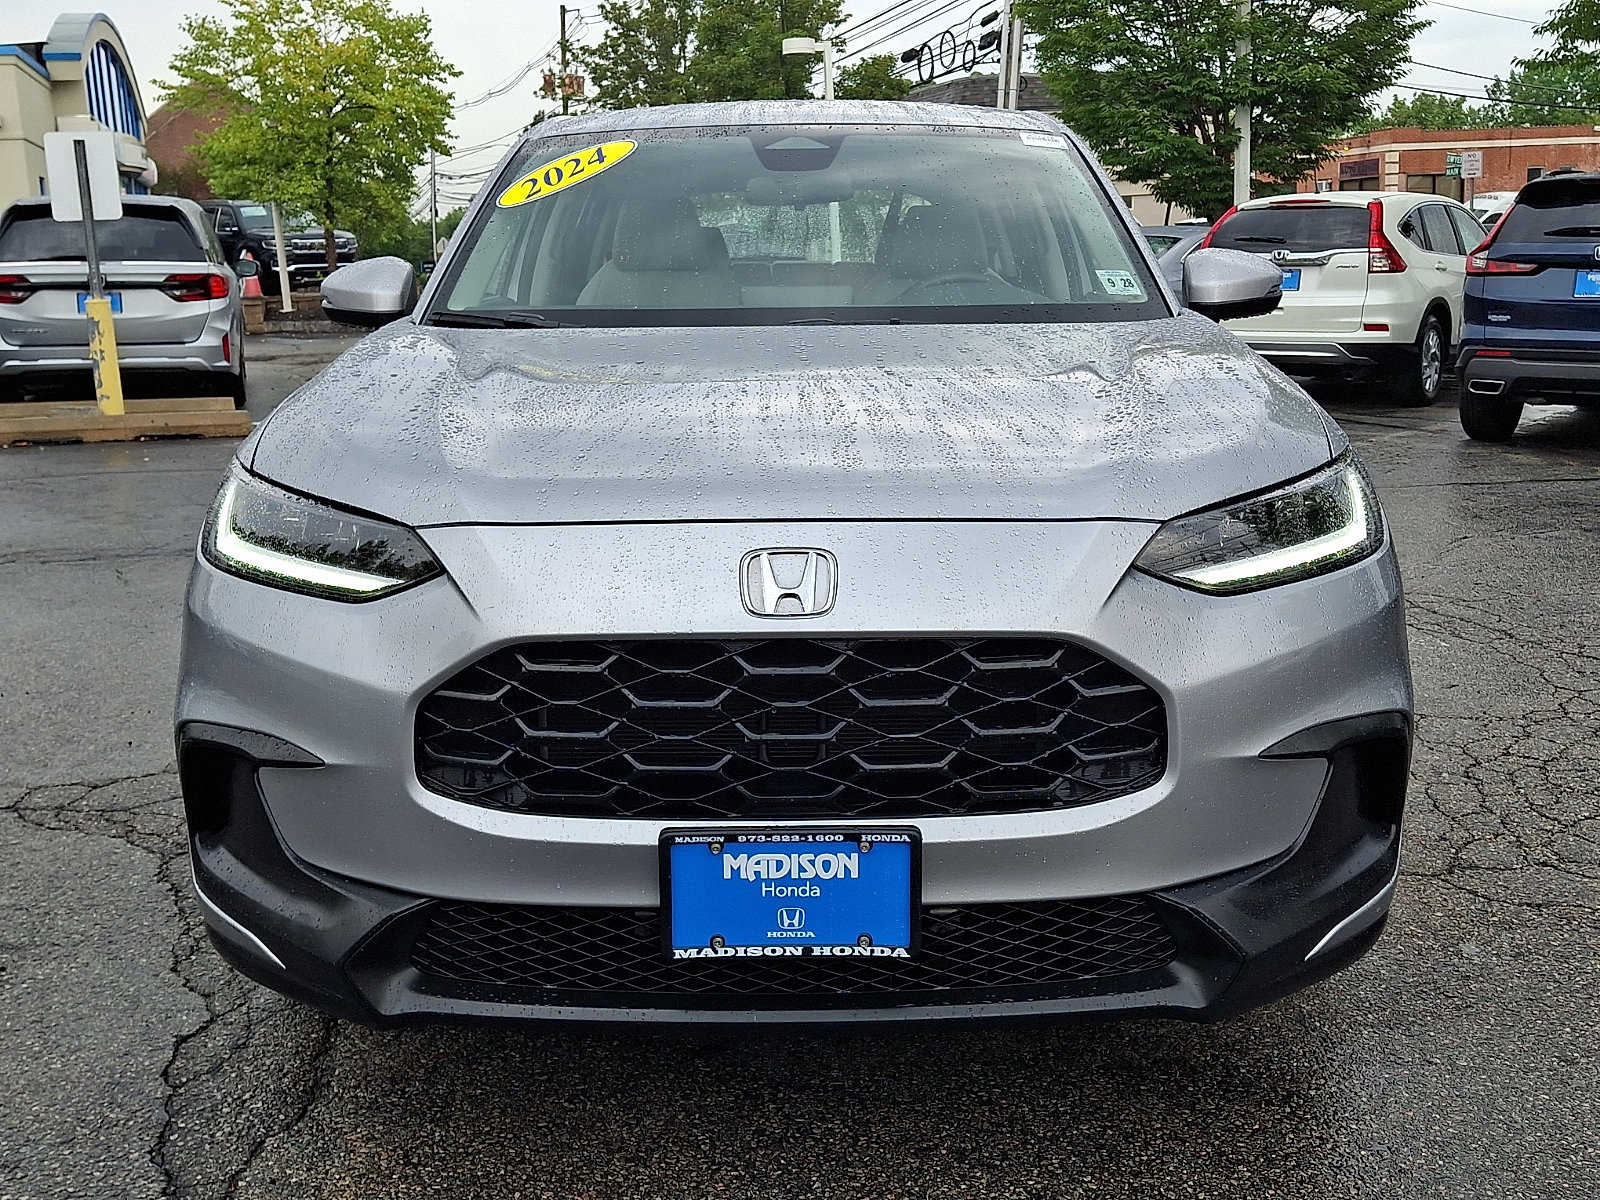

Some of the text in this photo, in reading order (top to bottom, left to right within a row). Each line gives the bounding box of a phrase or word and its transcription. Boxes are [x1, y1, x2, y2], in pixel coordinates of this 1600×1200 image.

[521, 147, 607, 200] 2024
[1107, 278, 1134, 287] 9 28
[737, 834, 844, 842] 973-822-1600
[860, 834, 911, 842] HONDA
[723, 853, 859, 882] MADISON
[761, 881, 821, 898] Honda
[673, 946, 911, 959] MADISON HONDA
